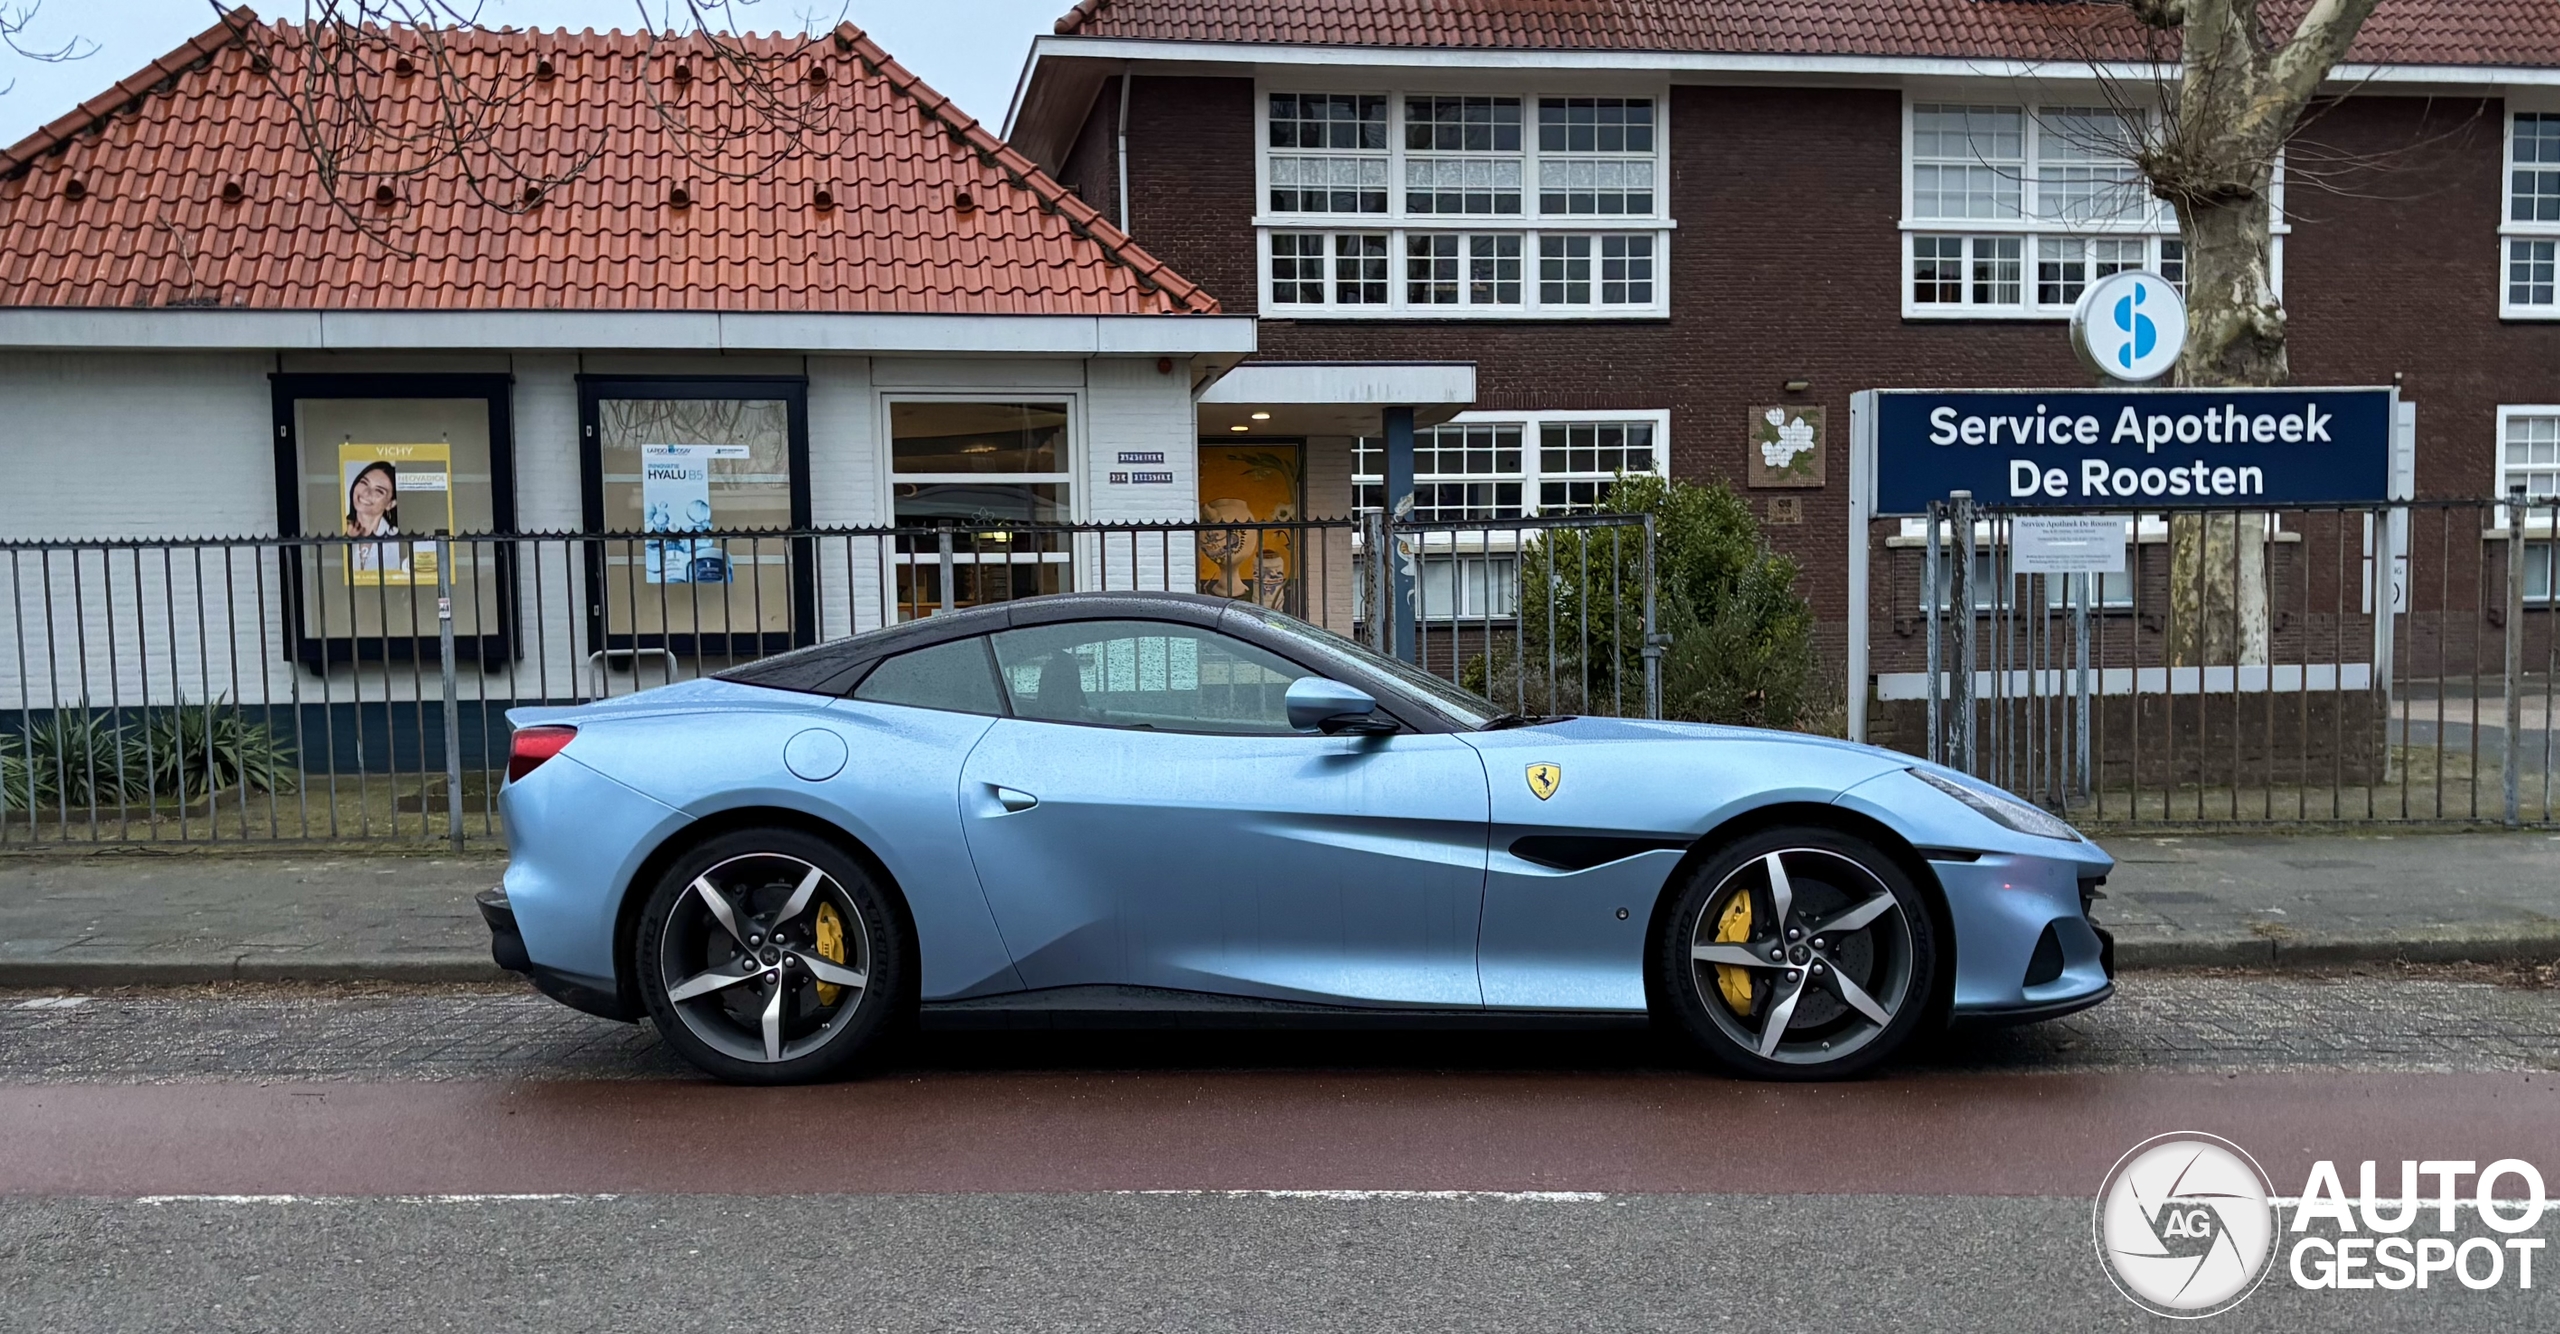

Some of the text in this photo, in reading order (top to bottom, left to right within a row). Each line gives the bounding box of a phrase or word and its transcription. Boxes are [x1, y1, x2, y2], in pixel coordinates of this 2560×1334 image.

[1929, 403, 2333, 454] Service Apotheek
[376, 446, 414, 456] VICHY
[648, 469, 704, 481] HYALU B5
[2010, 459, 2264, 498] De Roosten
[2021, 520, 2118, 529] Service Apotheek De Roosten
